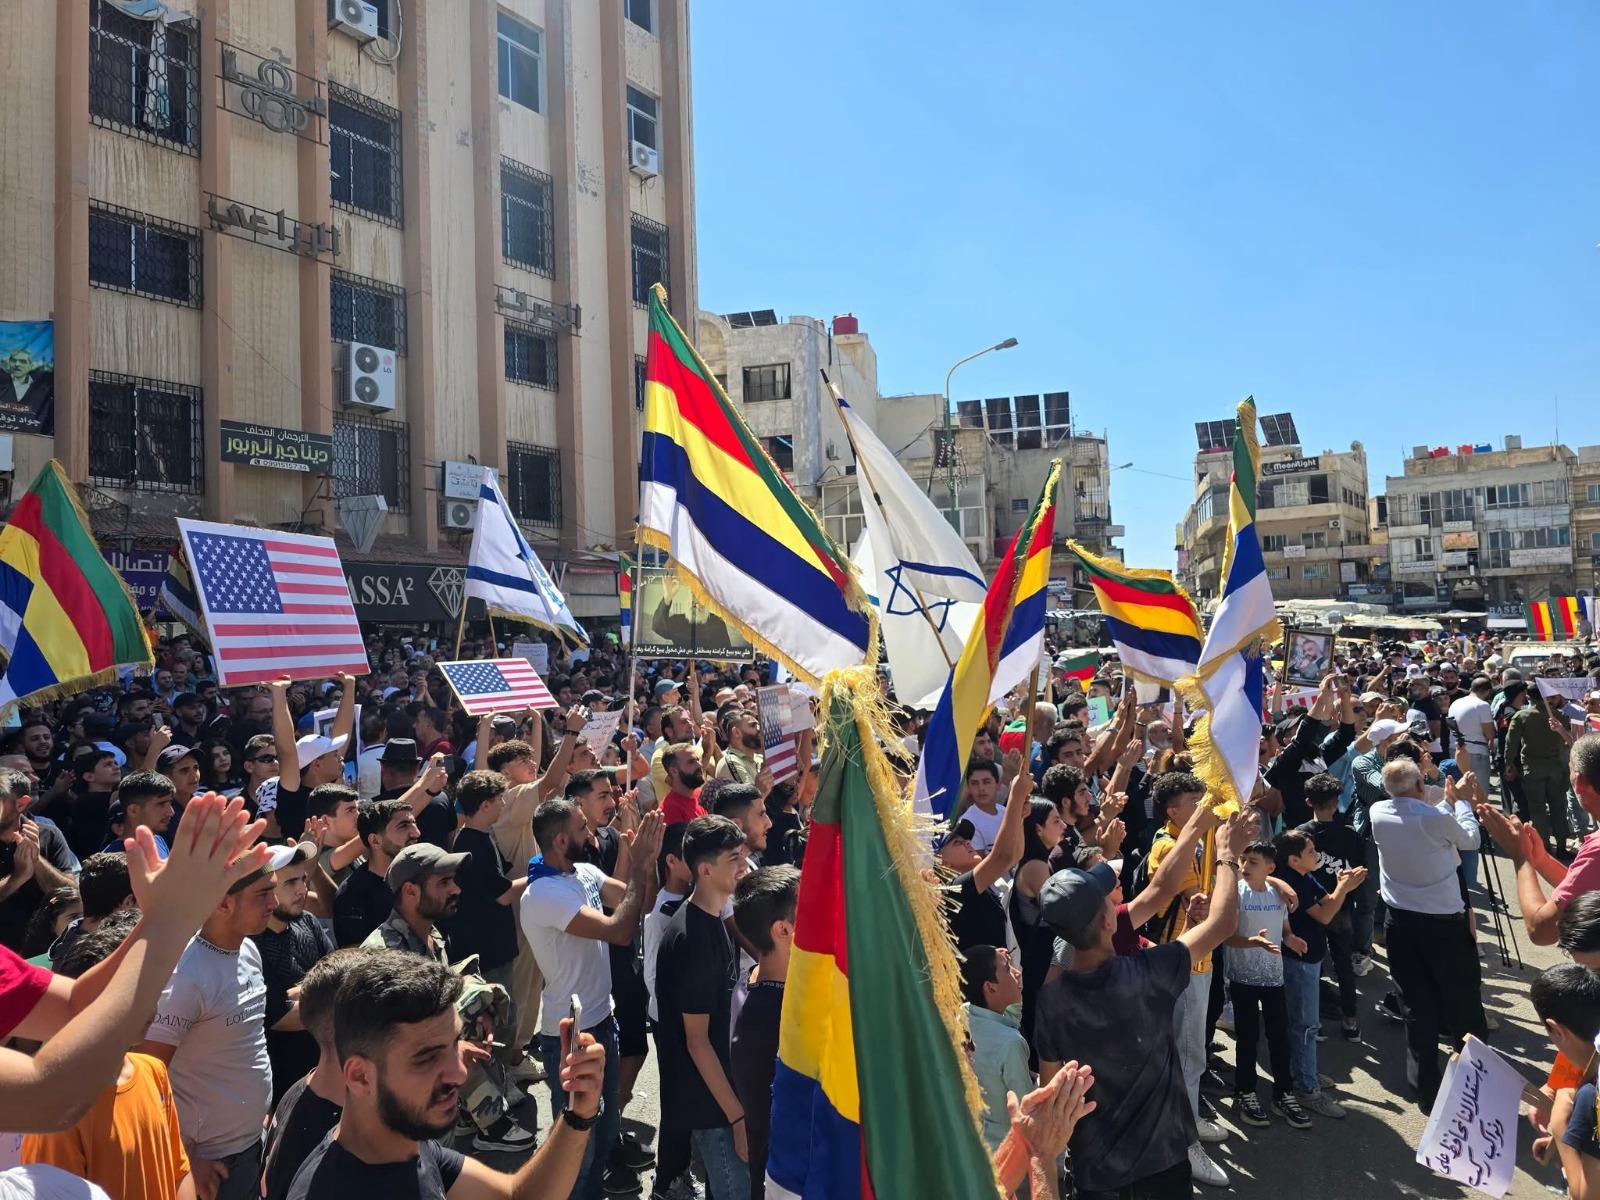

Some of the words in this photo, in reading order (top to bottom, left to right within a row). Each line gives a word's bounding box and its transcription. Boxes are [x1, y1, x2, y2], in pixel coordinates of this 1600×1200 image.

[19, 416, 41, 426] جواد
[245, 426, 275, 437] المحلف
[278, 430, 309, 443] الترجمان
[301, 443, 328, 464] دينا
